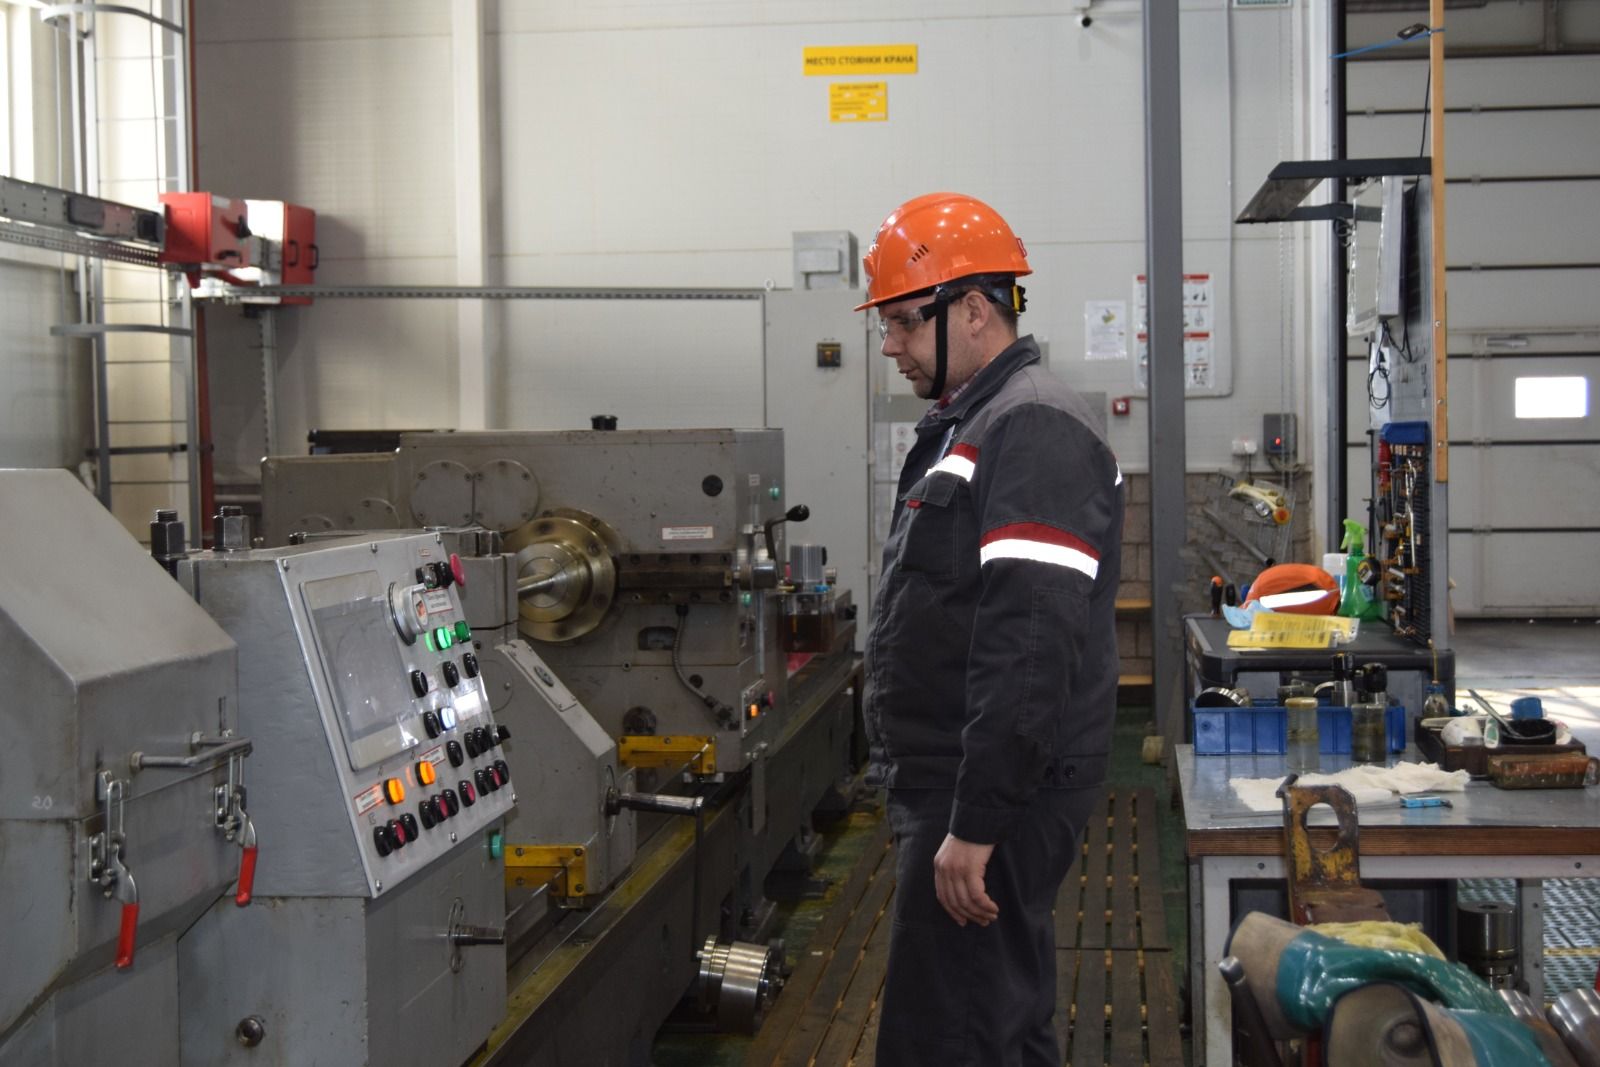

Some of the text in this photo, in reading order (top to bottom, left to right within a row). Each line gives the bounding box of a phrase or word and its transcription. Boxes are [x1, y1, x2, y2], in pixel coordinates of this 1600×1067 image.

[805, 55, 914, 66] МЕСТО СТОЯНКИ КРАНА
